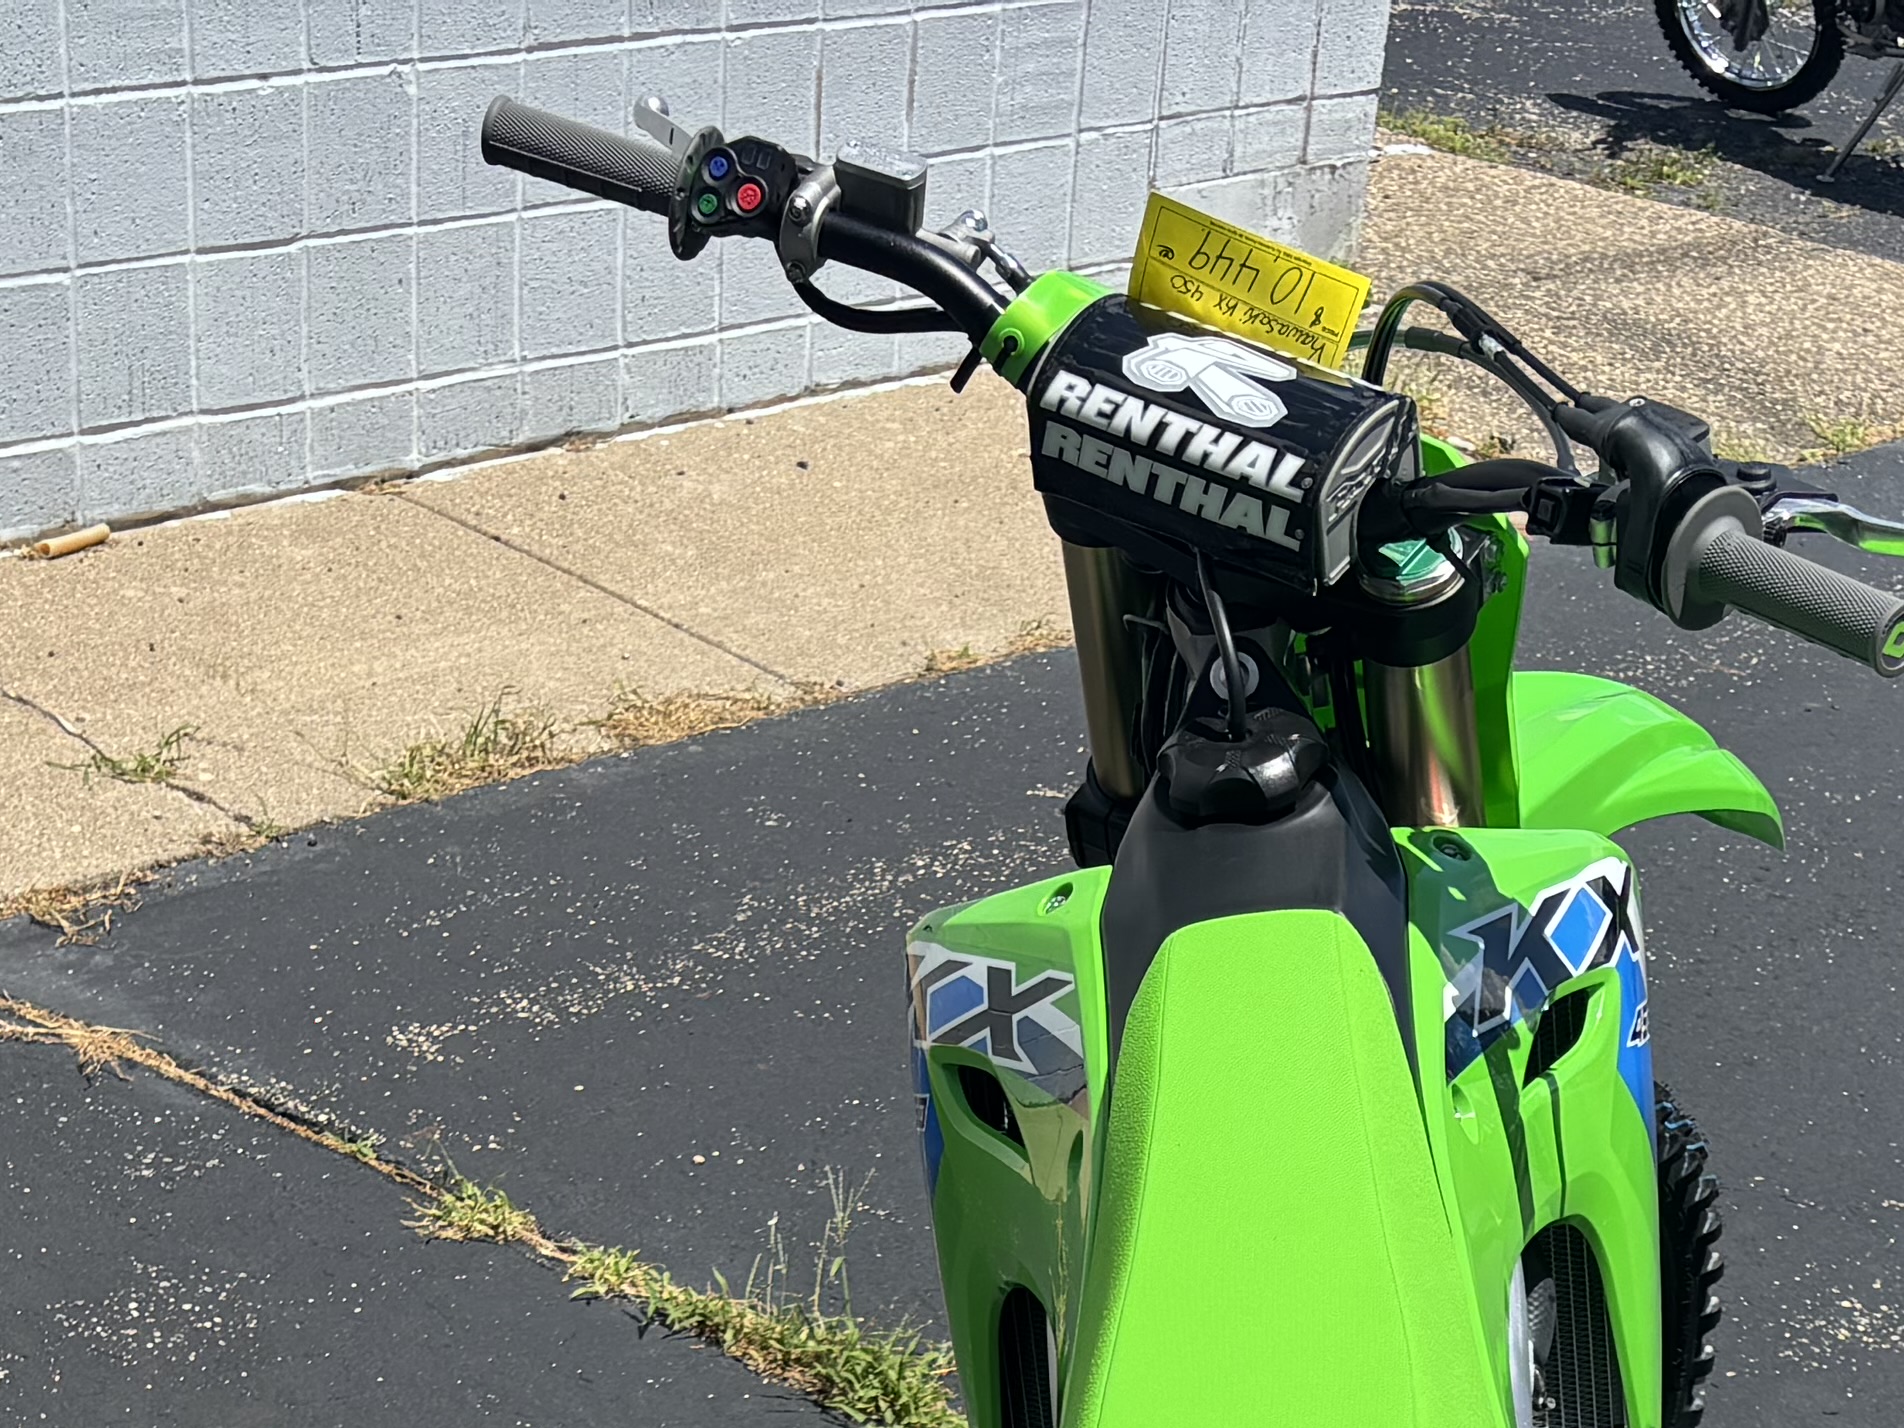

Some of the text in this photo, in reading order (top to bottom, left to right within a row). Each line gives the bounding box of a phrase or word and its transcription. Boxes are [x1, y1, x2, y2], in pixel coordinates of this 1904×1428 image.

[1170, 274, 1205, 302] 450
[1040, 370, 1306, 503] RENTHAL
[1042, 420, 1301, 552] RENTHAL
[1449, 860, 1641, 1034] KX
